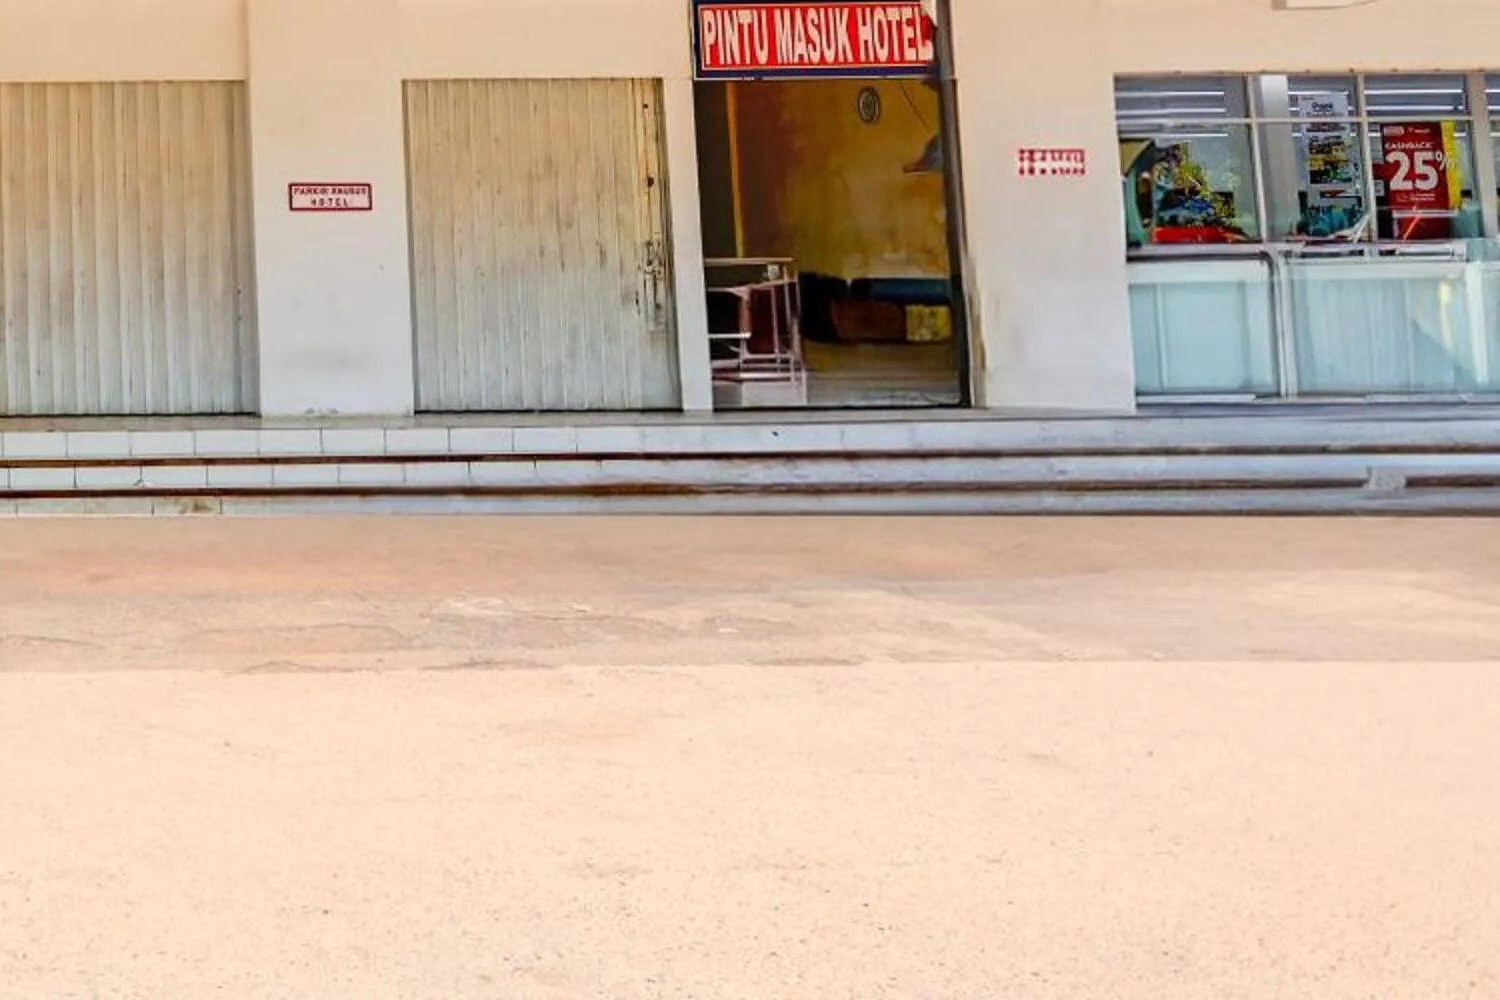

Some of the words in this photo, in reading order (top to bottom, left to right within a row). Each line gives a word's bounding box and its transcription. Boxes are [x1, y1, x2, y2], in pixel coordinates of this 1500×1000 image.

[701, 7, 770, 65] PINTU
[773, 6, 853, 64] MASUK
[856, 4, 933, 62] HOTEL
